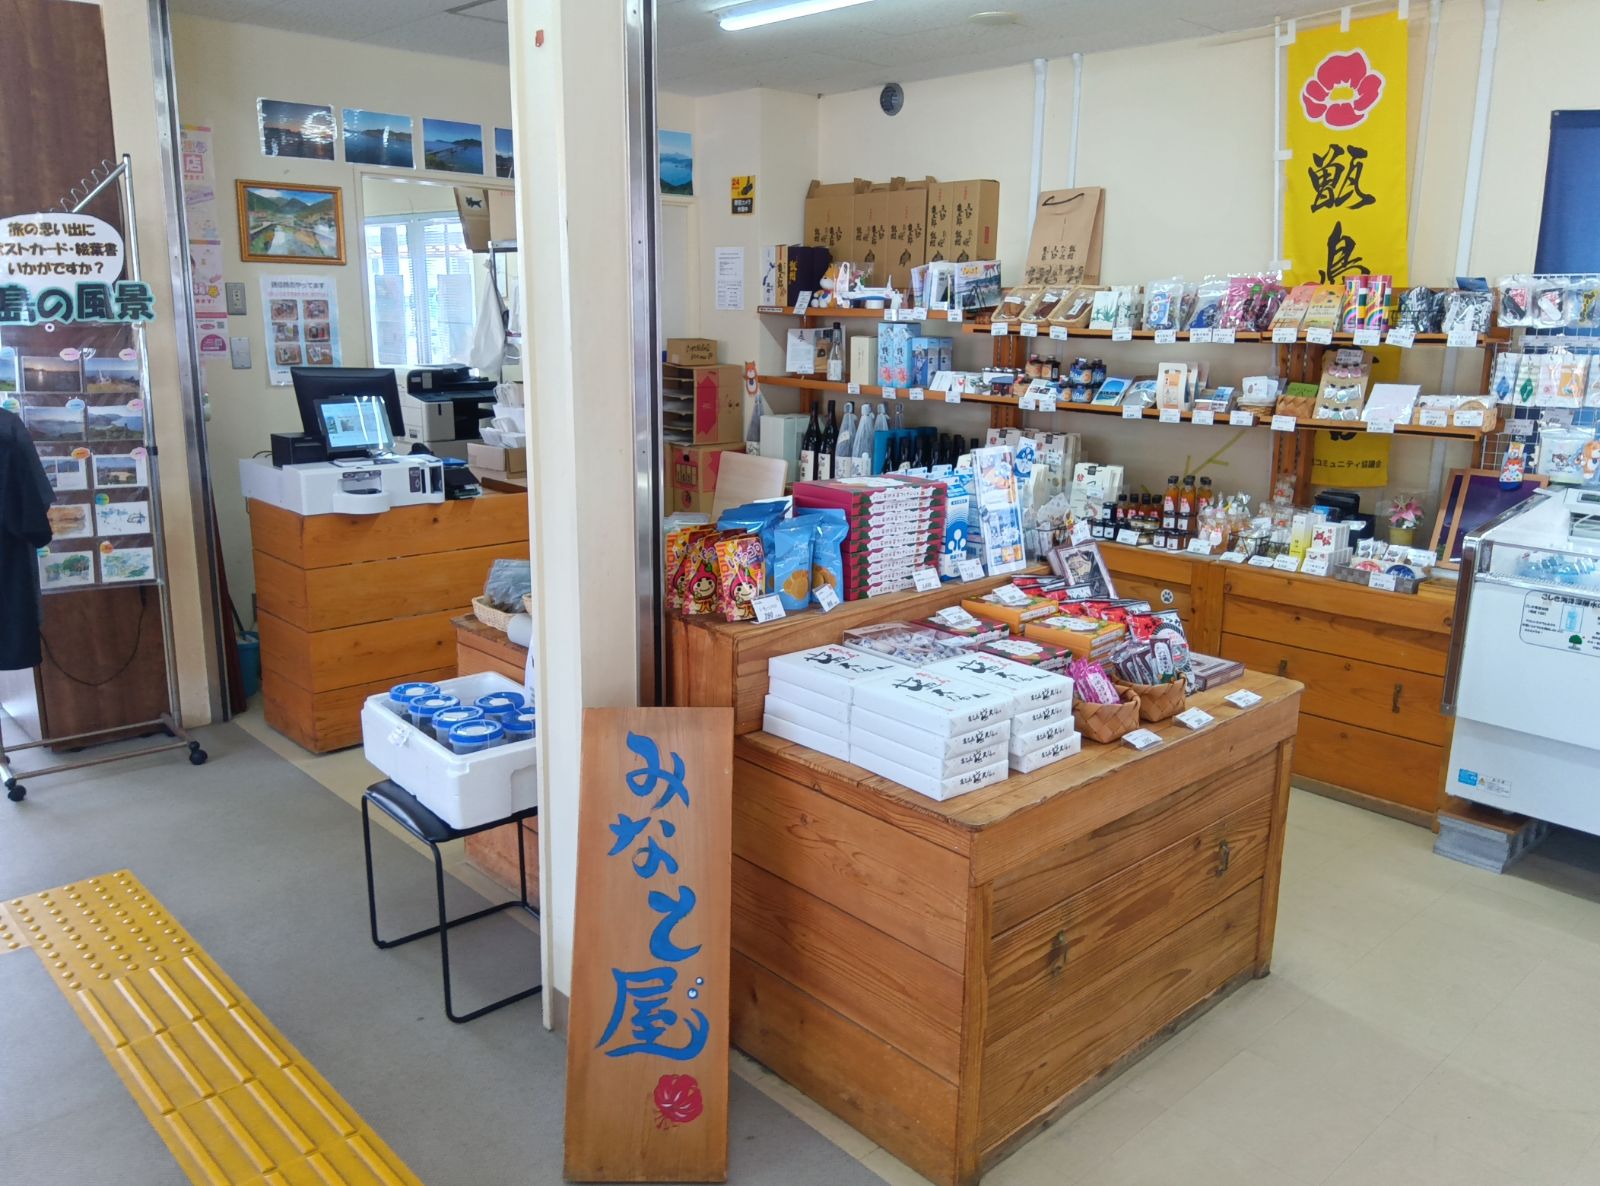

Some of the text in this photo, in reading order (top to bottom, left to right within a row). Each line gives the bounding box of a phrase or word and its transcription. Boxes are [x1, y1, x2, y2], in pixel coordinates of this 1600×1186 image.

[8, 222, 96, 236] 旅の思い出に
[1312, 459, 1382, 469] コミュニティ協議会
[595, 730, 711, 1062] みなと屋
